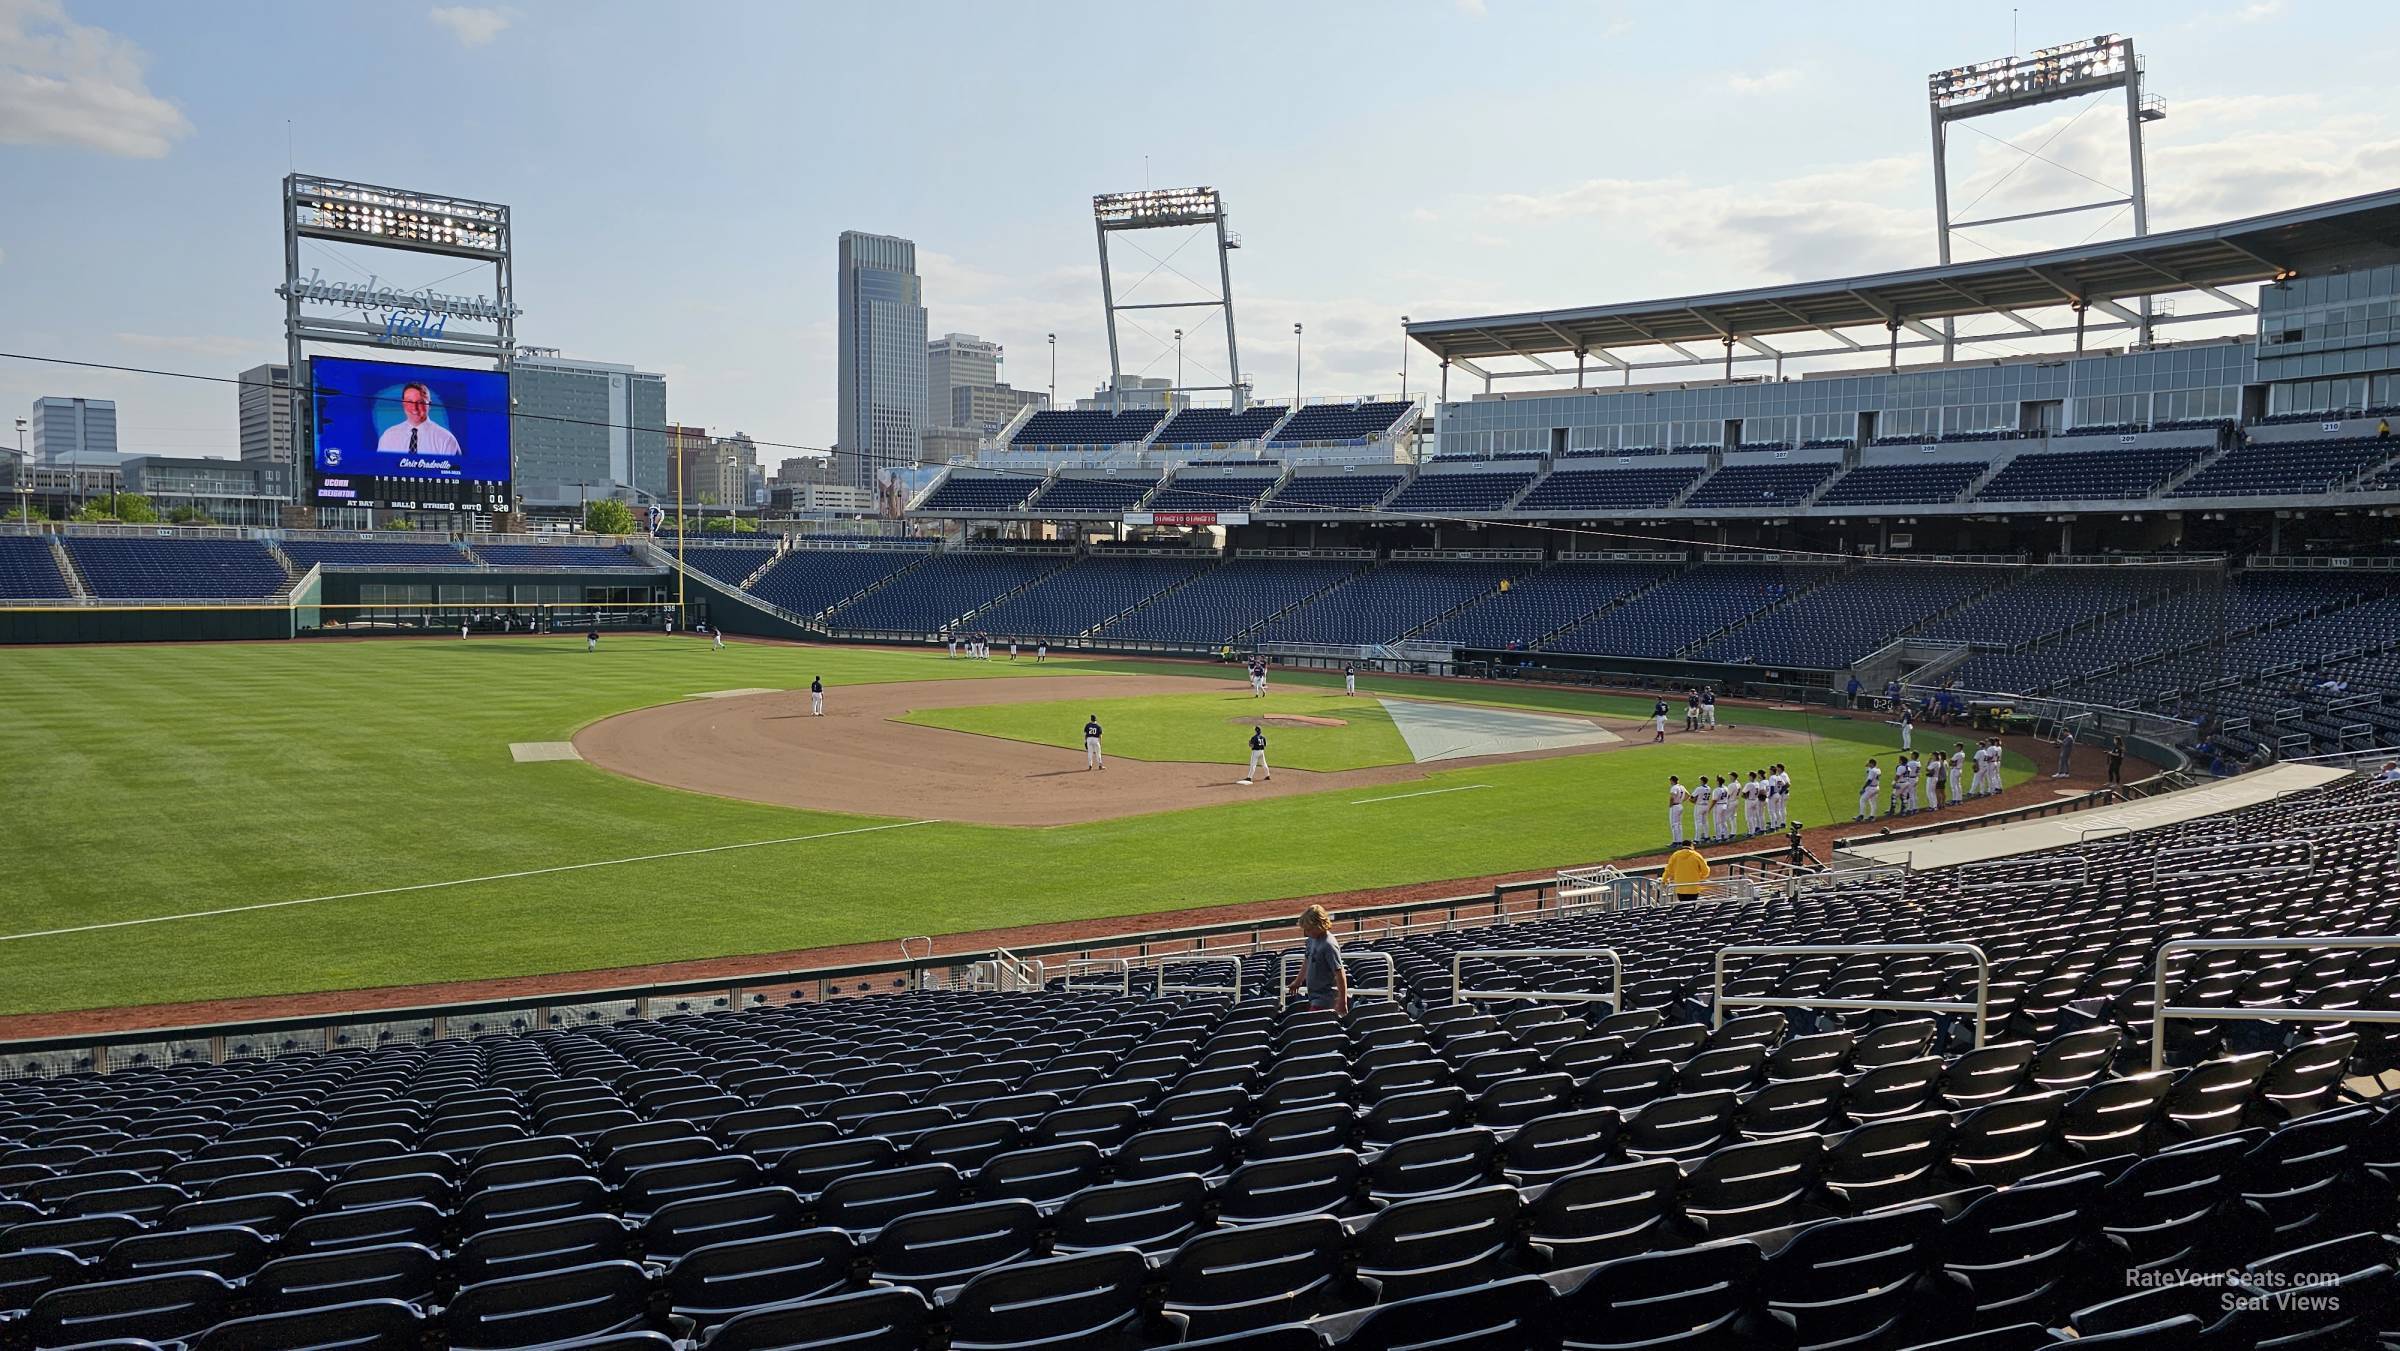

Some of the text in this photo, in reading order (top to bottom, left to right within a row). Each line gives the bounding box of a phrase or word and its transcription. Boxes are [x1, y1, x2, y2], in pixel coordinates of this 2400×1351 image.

[378, 310, 448, 342] field
[391, 335, 440, 350] OMAHA
[324, 478, 349, 487] UCONN
[318, 489, 355, 498] CREIGHTON
[422, 502, 449, 510] STRIKE
[492, 504, 509, 512] 5:28
[1088, 727, 1097, 735] 20
